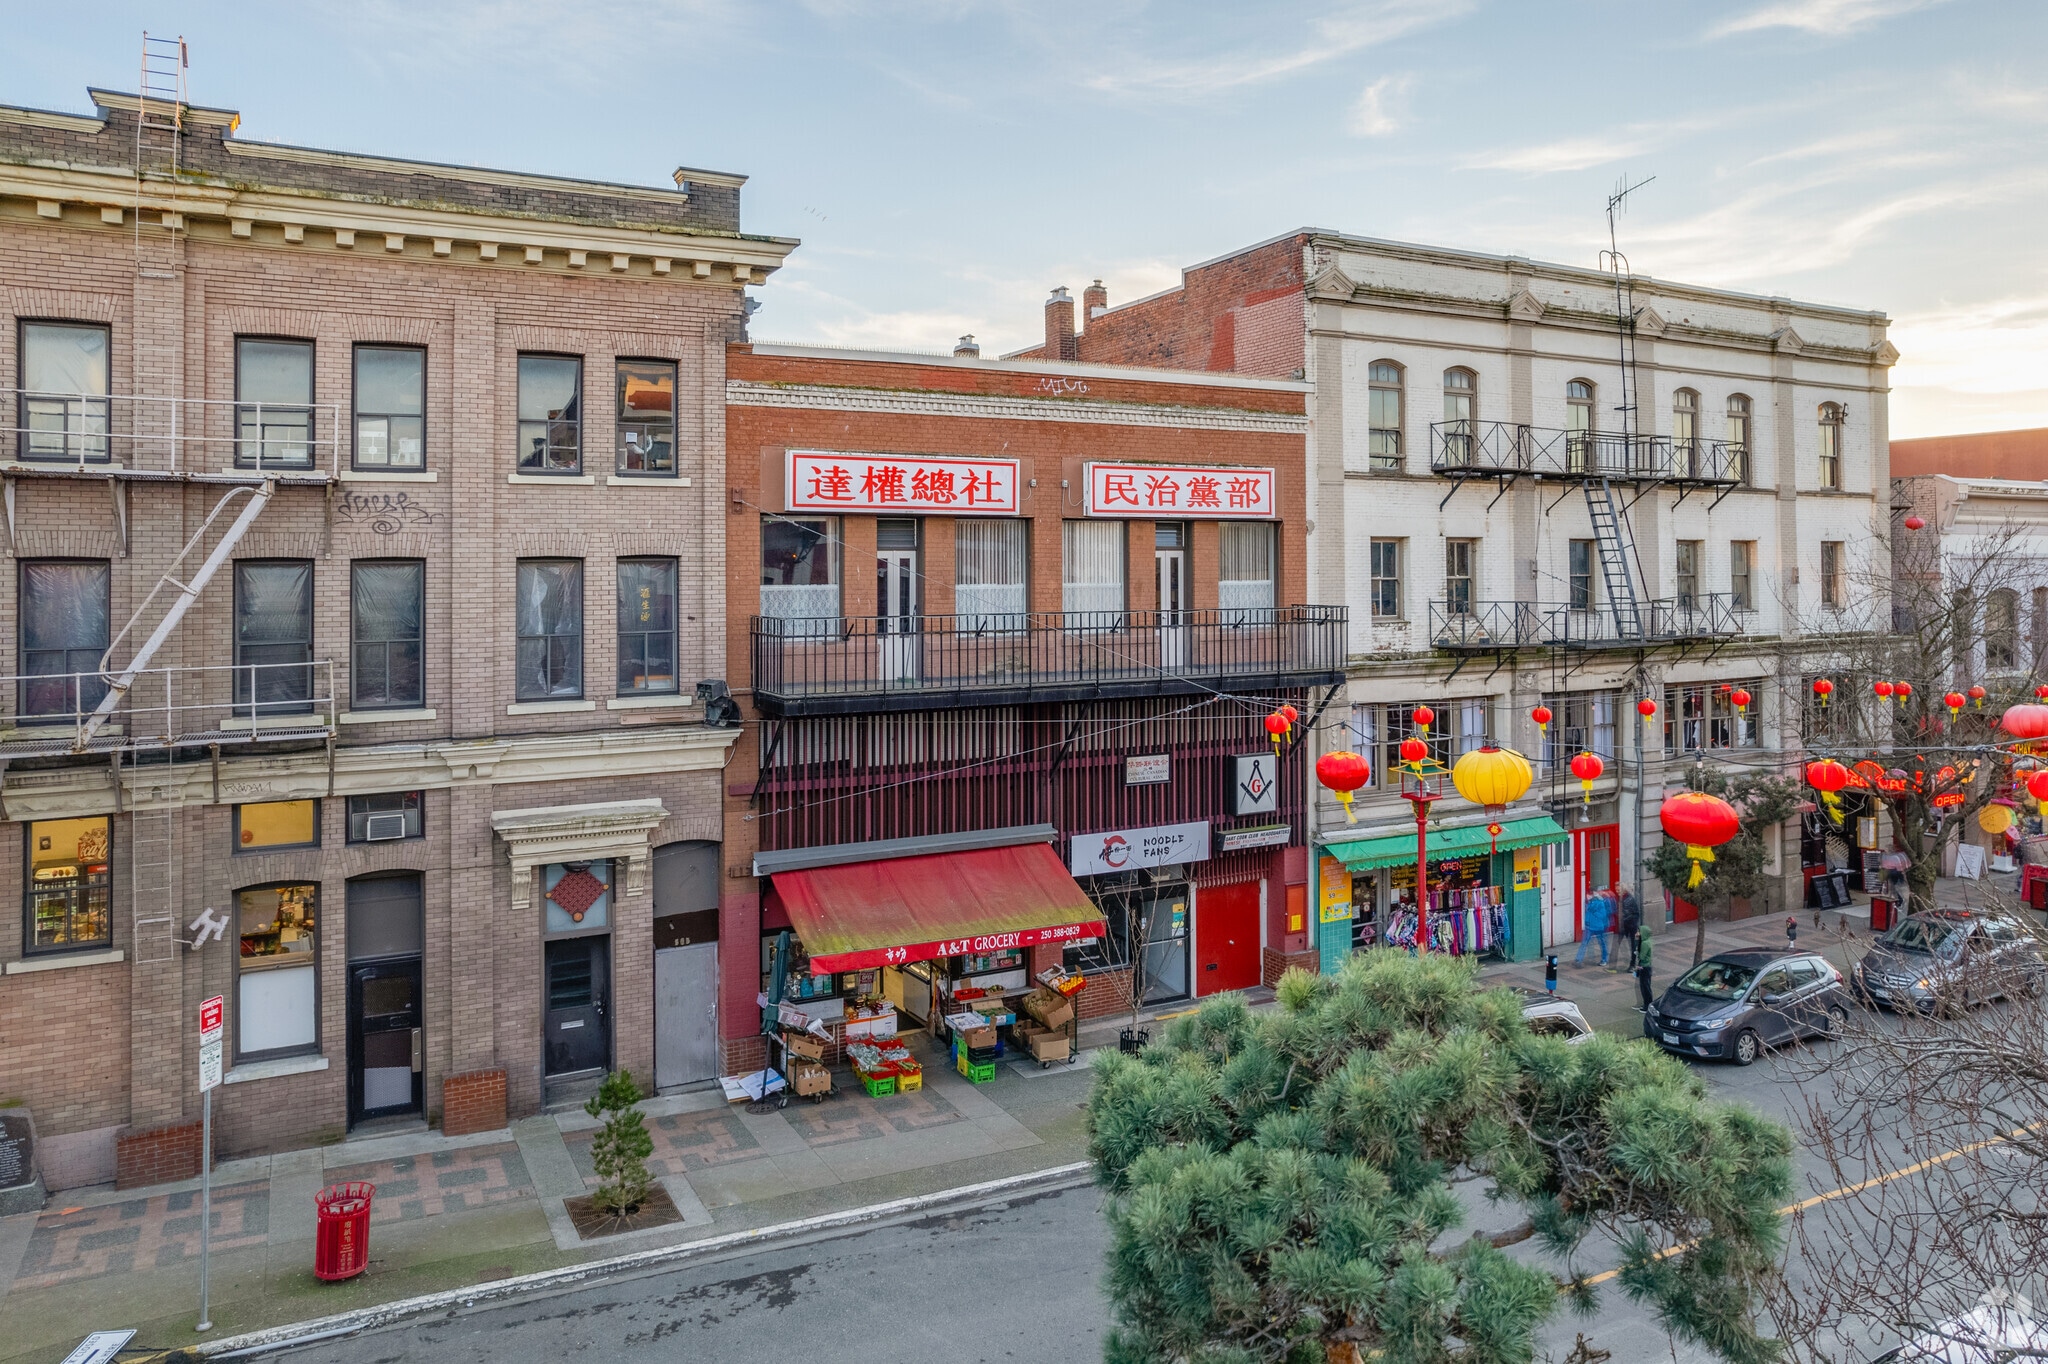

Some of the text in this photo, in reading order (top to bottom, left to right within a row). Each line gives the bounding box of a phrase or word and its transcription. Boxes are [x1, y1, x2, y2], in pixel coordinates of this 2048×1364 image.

[807, 465, 1004, 506] 達權總社
[1104, 473, 1261, 508] 民治黨部
[1251, 779, 1261, 793] G
[1936, 793, 1965, 807] OPEN
[1260, 829, 1290, 837] HEADQUARTERS
[1143, 834, 1185, 847] NOODLE
[1143, 846, 1170, 858] FANS
[1440, 861, 1462, 872] OPEN
[936, 939, 970, 957] A&T
[974, 932, 1021, 951] GROCERY
[1040, 929, 1052, 940] 250
[1053, 926, 1080, 939] 388-0829
[204, 1007, 219, 1019] LOADING
[207, 1016, 217, 1026] ZONE
[74, 1335, 101, 1358] CLOSED
